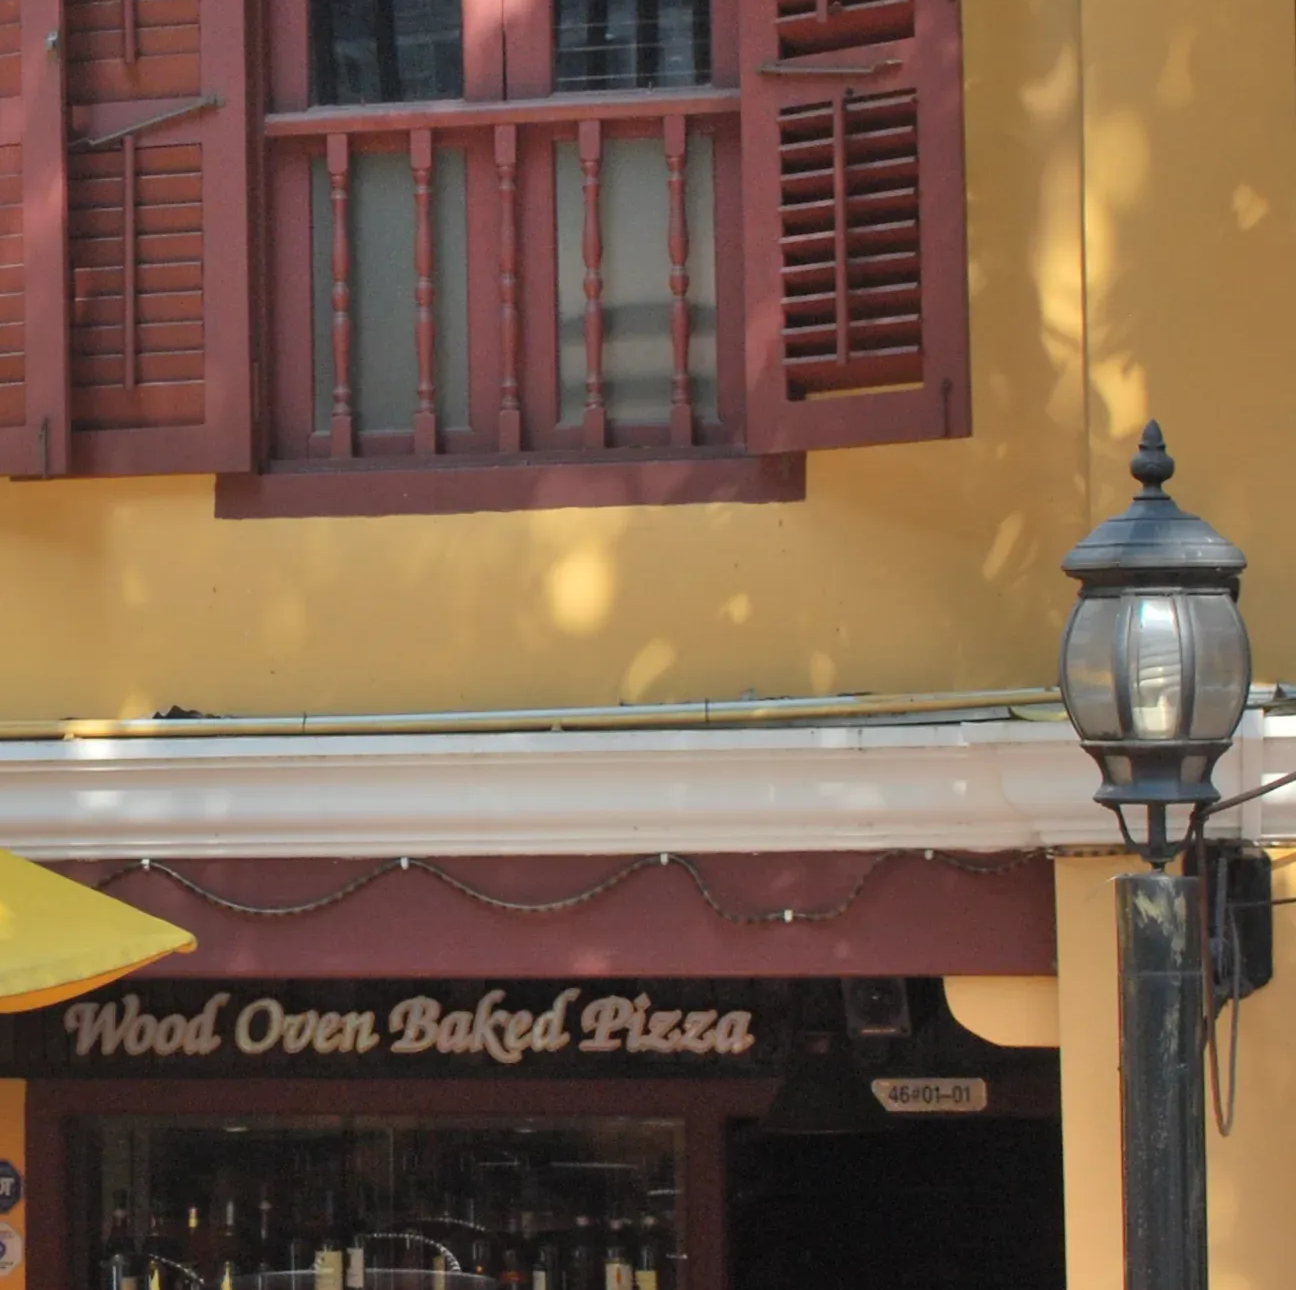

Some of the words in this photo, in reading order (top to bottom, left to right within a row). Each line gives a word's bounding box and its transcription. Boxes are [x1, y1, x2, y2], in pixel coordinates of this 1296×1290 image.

[63, 992, 232, 1056] Wood
[234, 997, 381, 1055] Oven
[388, 987, 582, 1064] Baked
[578, 992, 756, 1054] Pizza
